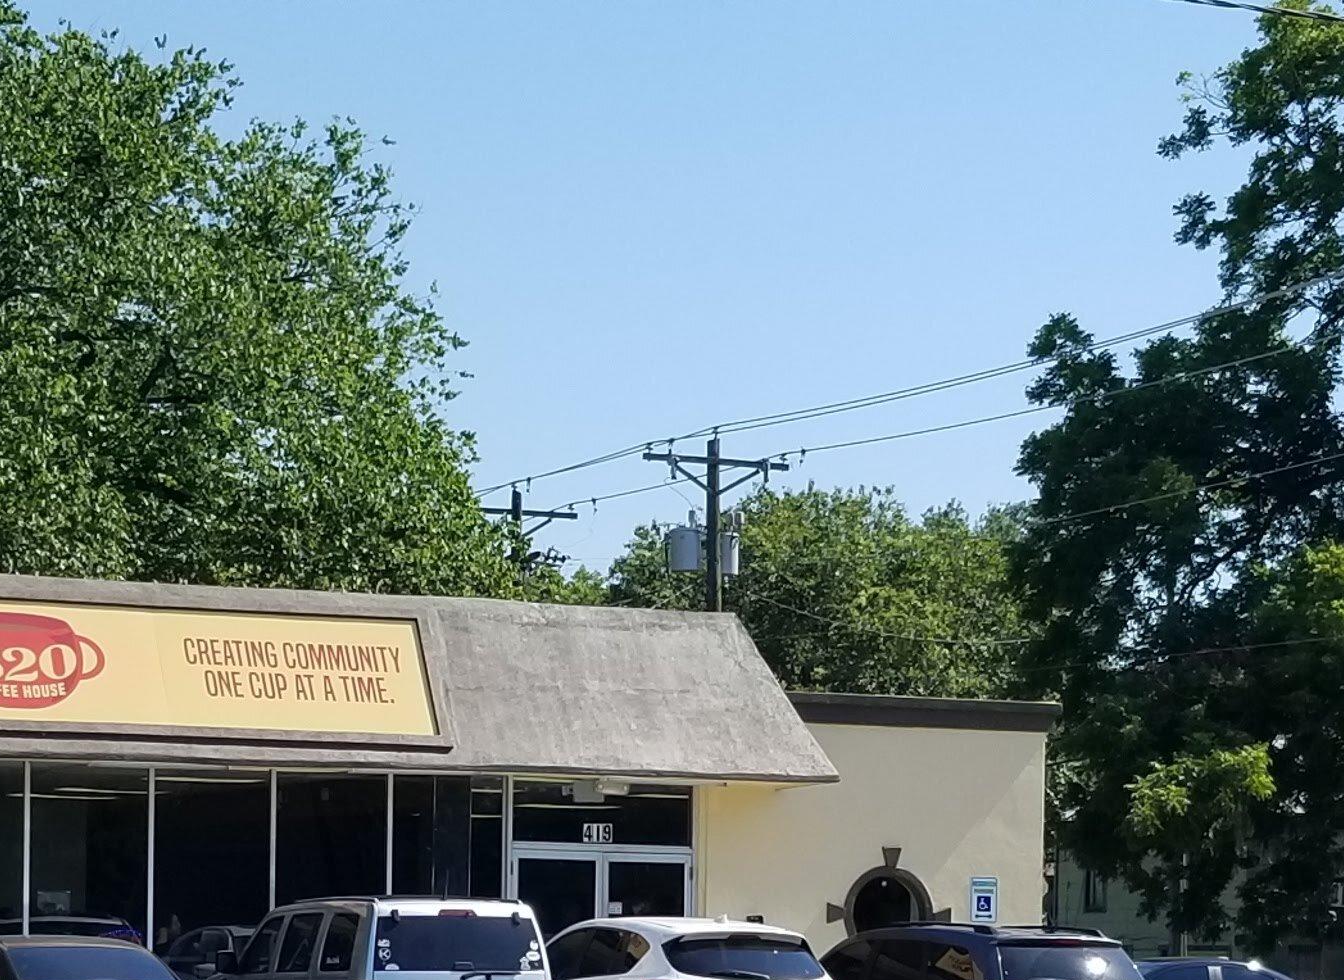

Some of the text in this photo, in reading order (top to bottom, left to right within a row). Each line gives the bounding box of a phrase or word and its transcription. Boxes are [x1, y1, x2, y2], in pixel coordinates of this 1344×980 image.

[184, 638, 400, 673] CREATING COMMUNITY
[23, 682, 66, 699] HOUSE
[205, 670, 395, 704] ONE CUP AT A TIME.
[584, 825, 612, 842] 419
